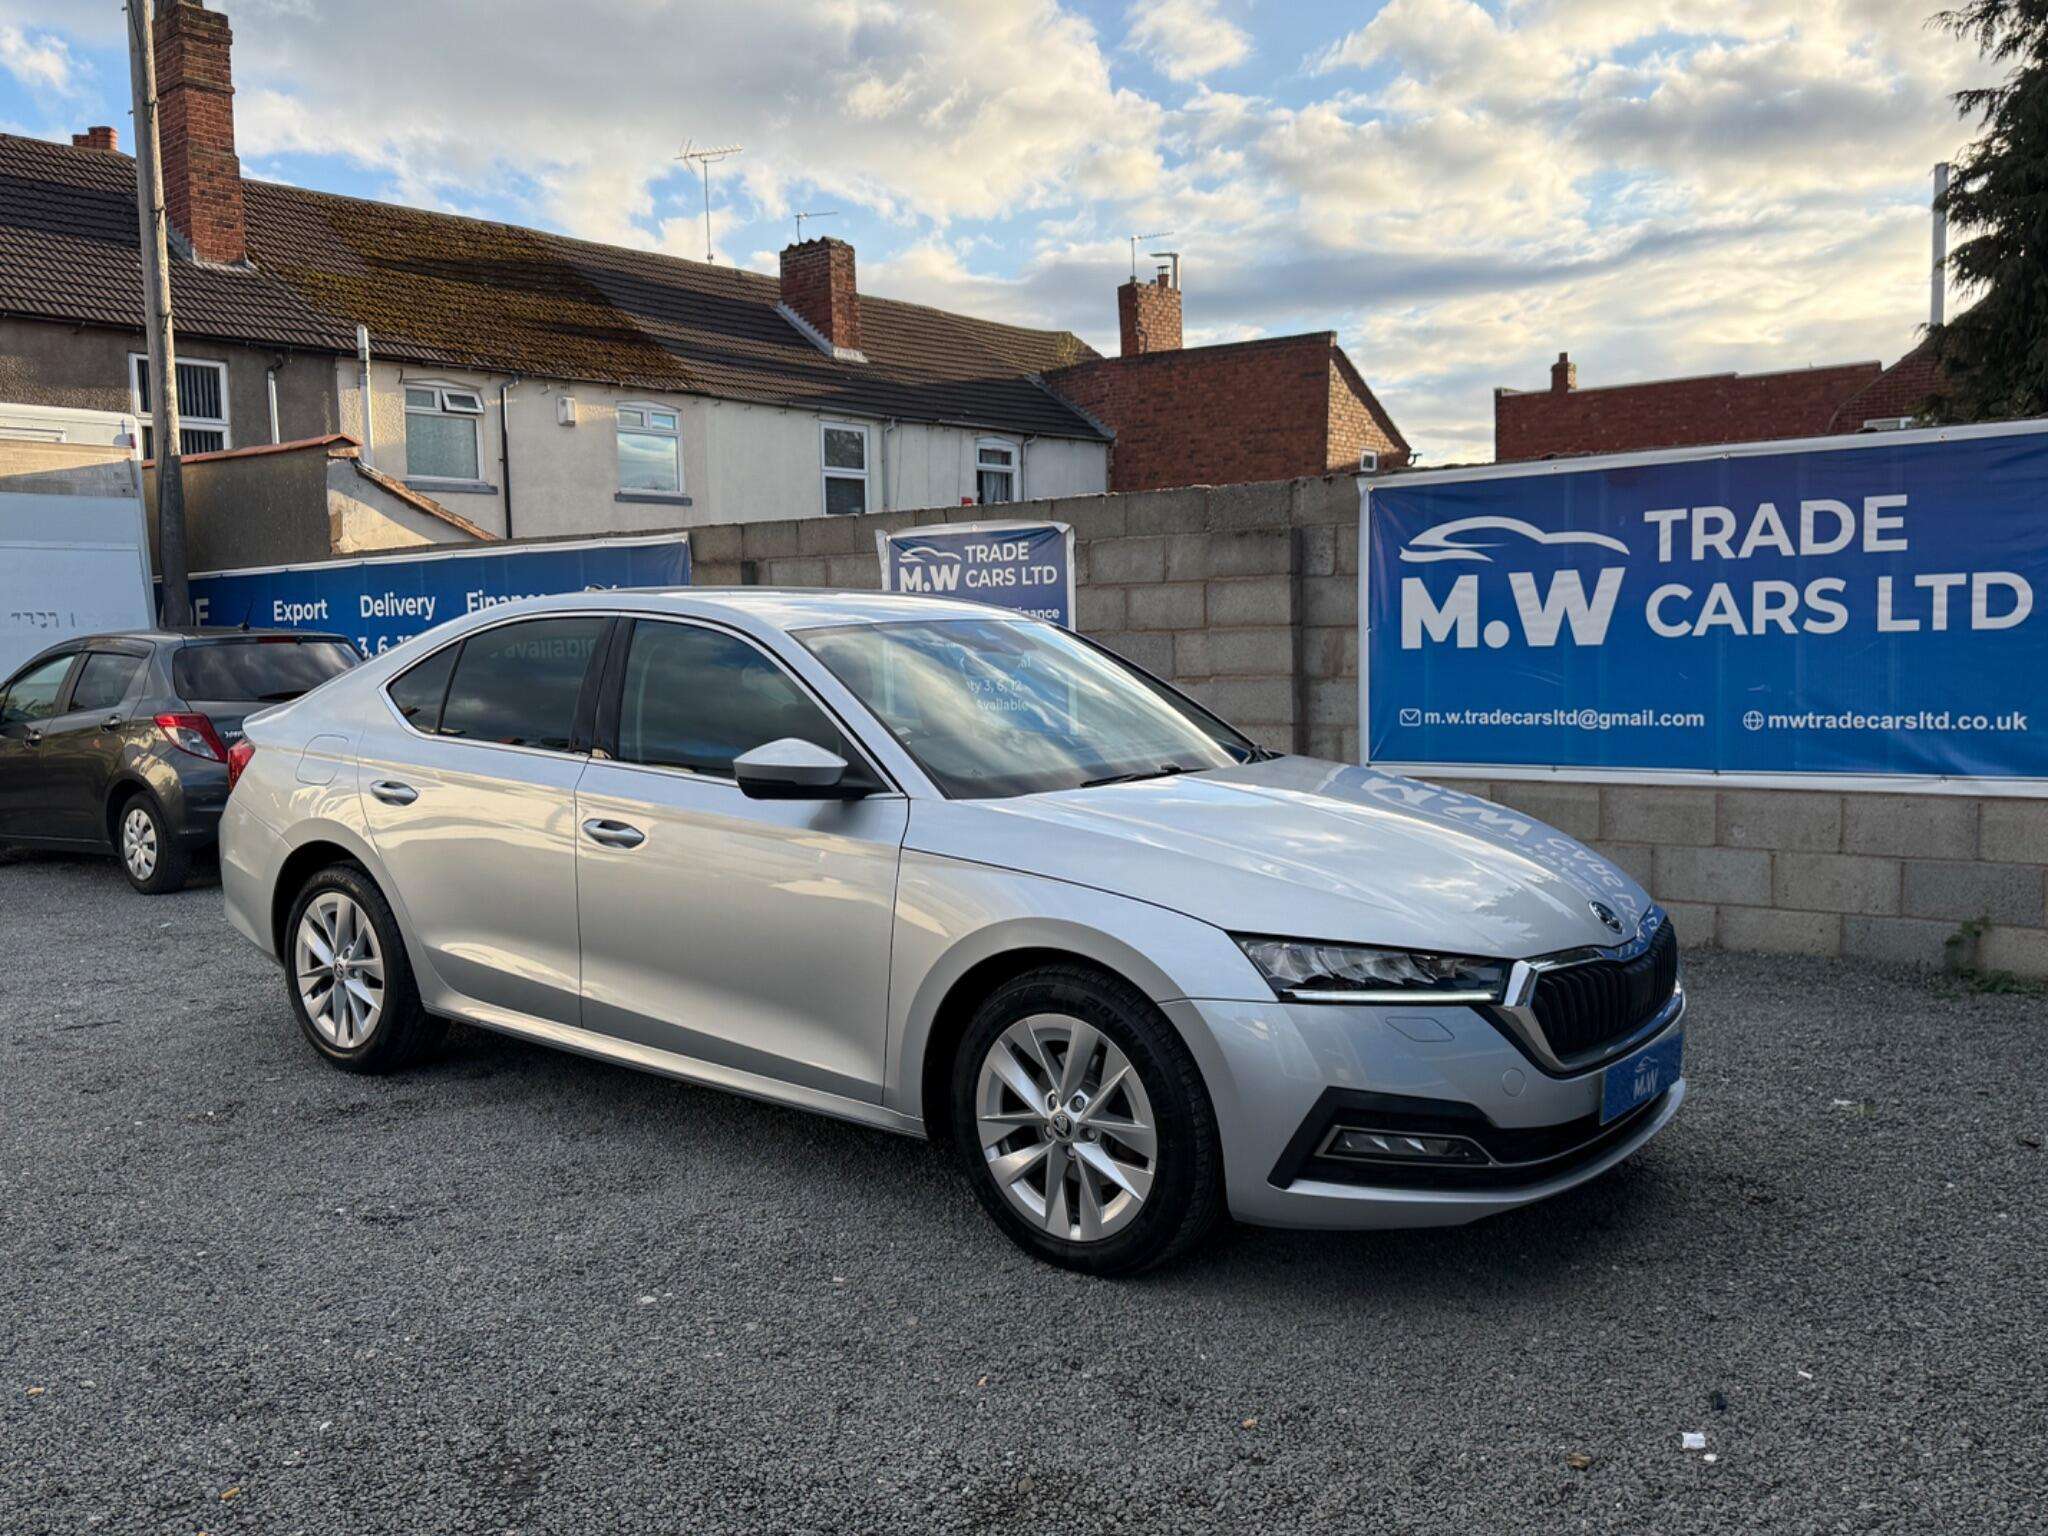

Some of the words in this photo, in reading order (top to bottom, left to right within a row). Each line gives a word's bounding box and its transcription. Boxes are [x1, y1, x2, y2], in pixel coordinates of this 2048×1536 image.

[1644, 494, 1908, 563] TRADE
[964, 542, 1030, 563] TRADE
[899, 564, 961, 592] M.W
[965, 567, 1016, 588] CARS
[1022, 565, 1058, 585] LTD
[273, 599, 329, 625] Export
[359, 591, 436, 621] Delivery
[466, 589, 547, 613] Fina
[1402, 567, 1626, 649] M.W
[1645, 577, 1849, 637] CARS
[1876, 571, 2034, 632] LTD
[1424, 708, 1705, 730] m.w.tradecarsltd@gmail.com
[1767, 711, 2028, 731] mwtradecarsltd.co.uk
